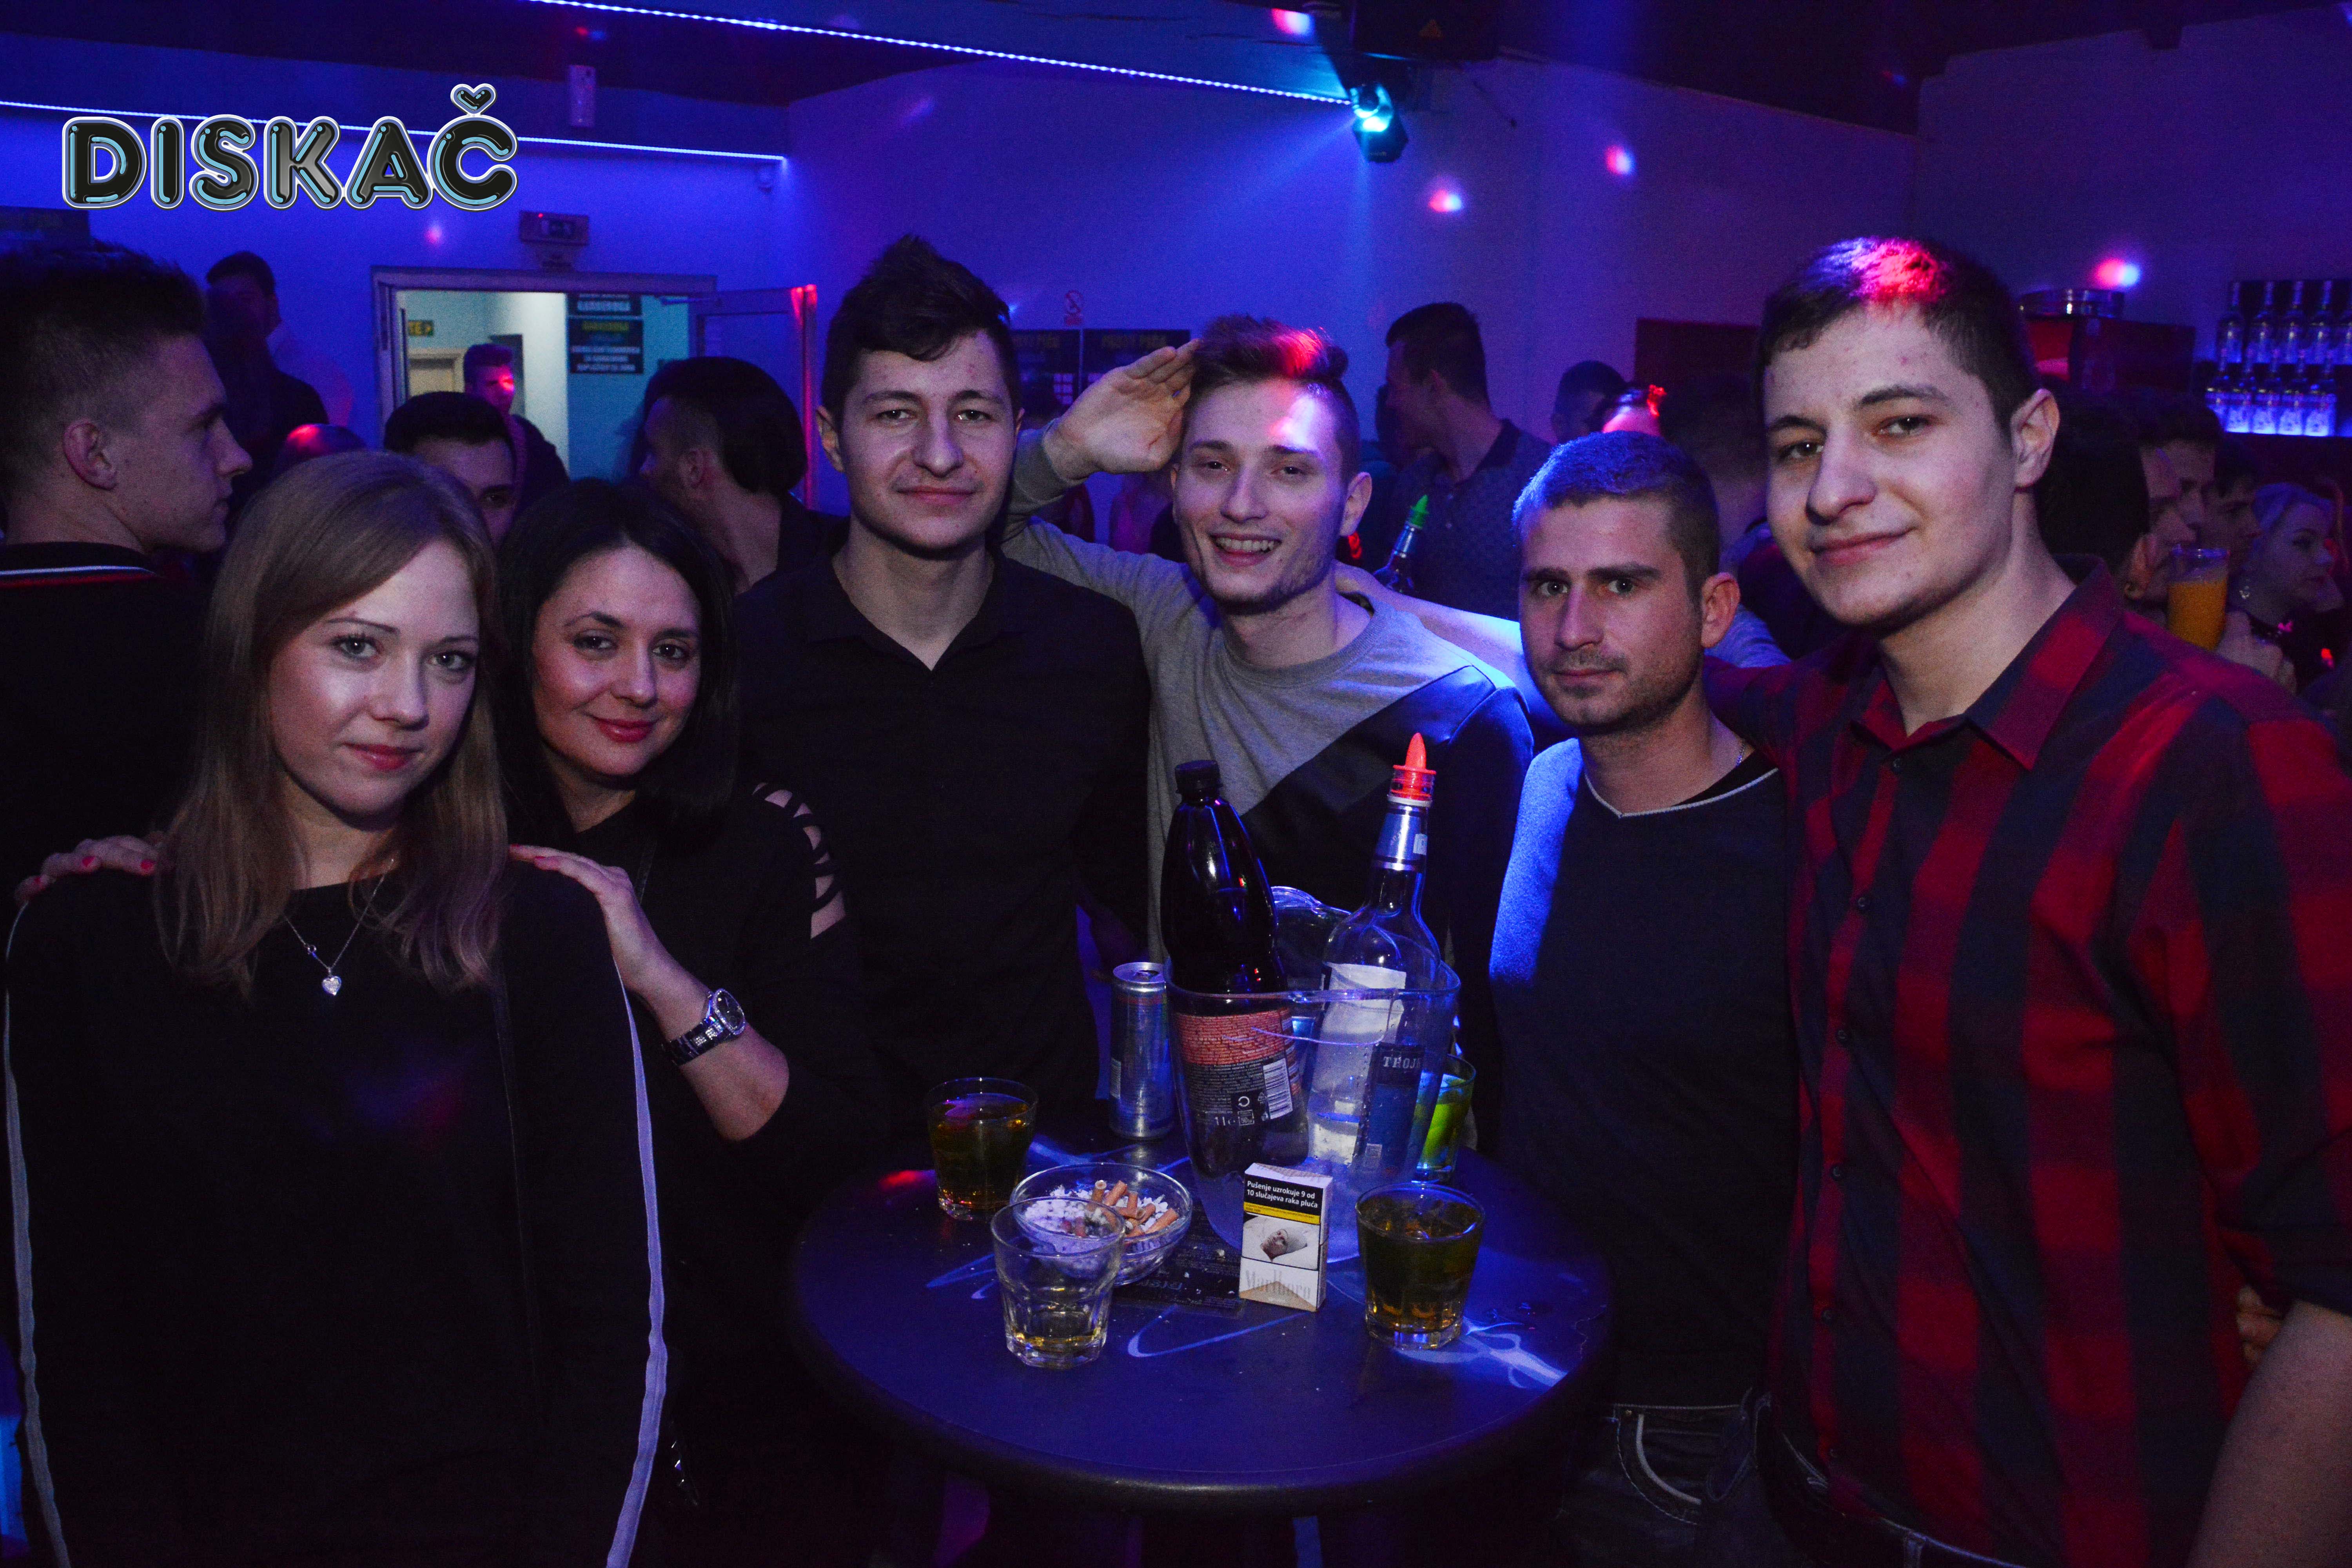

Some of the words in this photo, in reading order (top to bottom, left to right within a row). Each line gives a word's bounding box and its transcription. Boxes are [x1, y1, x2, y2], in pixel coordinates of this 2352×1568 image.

[1247, 1180, 1271, 1192] Pušenje
[1273, 1187, 1300, 1197] uzrokuje
[1255, 1191, 1284, 1201] slučajeva
[1301, 1199, 1318, 1208] pluća
